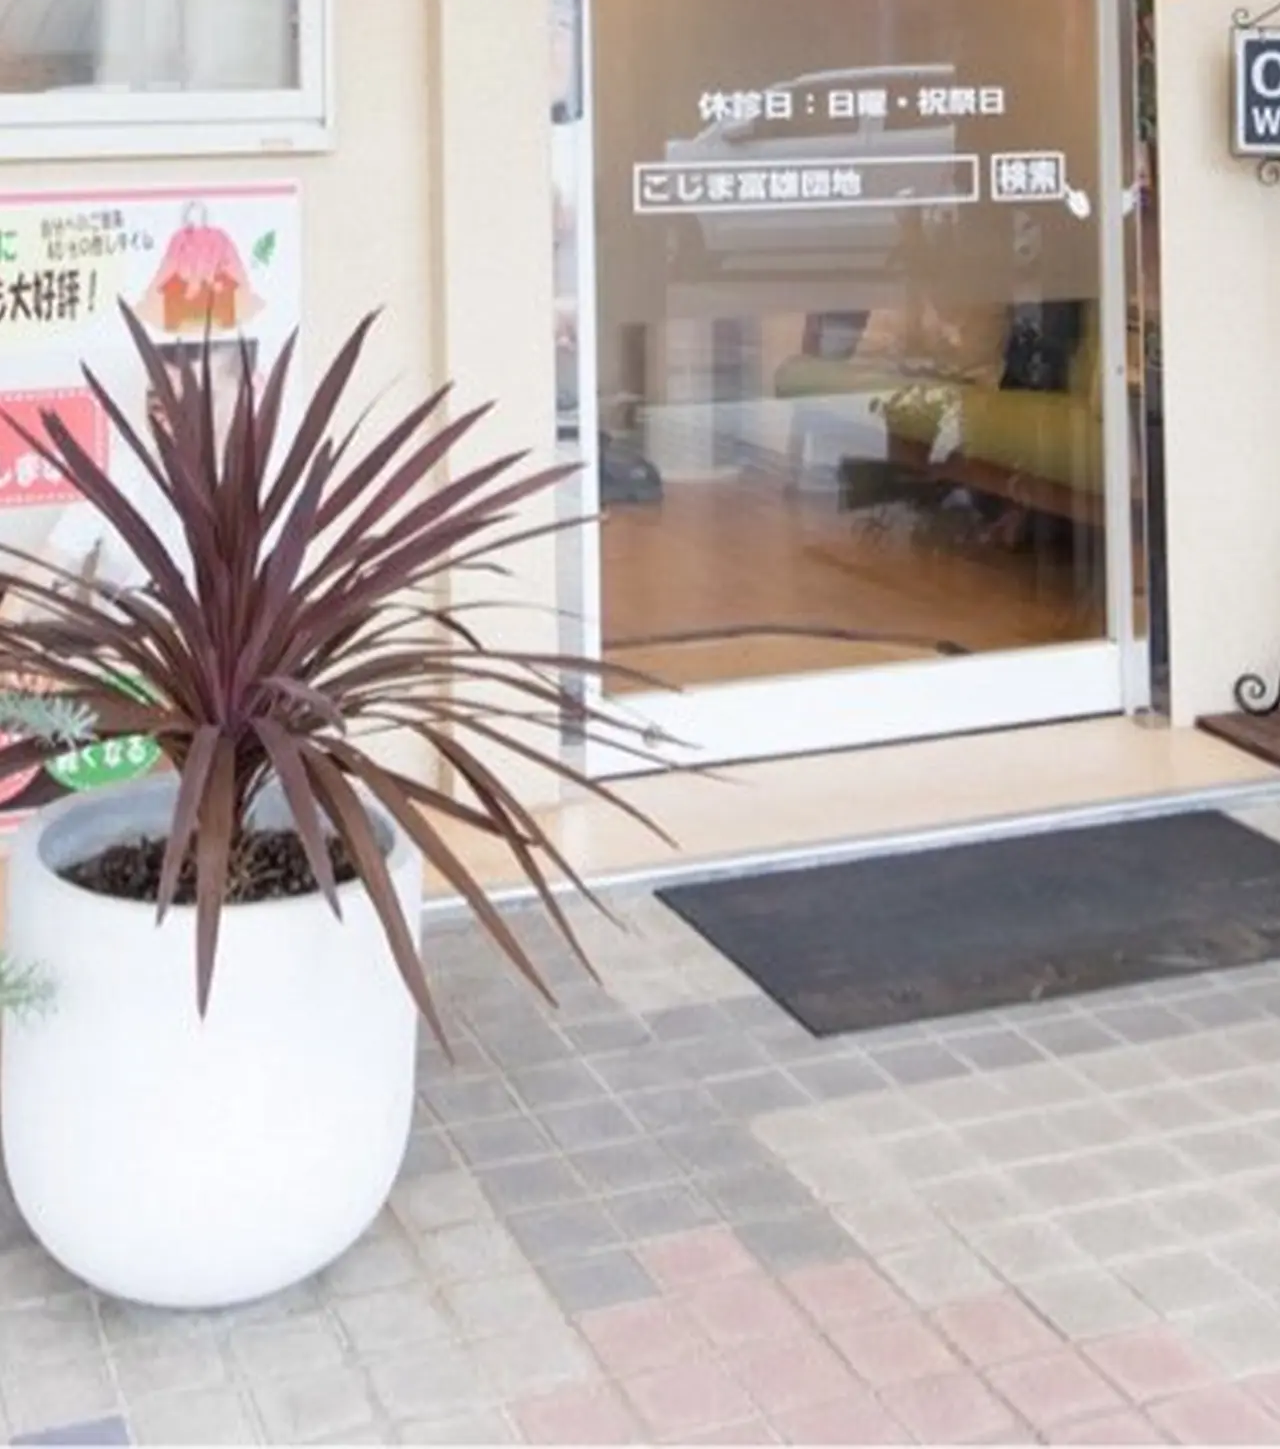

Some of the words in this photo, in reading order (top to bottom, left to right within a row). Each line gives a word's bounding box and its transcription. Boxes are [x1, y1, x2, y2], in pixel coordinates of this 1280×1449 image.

[642, 167, 862, 201] こじま富雄団地
[1000, 159, 1056, 194] 検索
